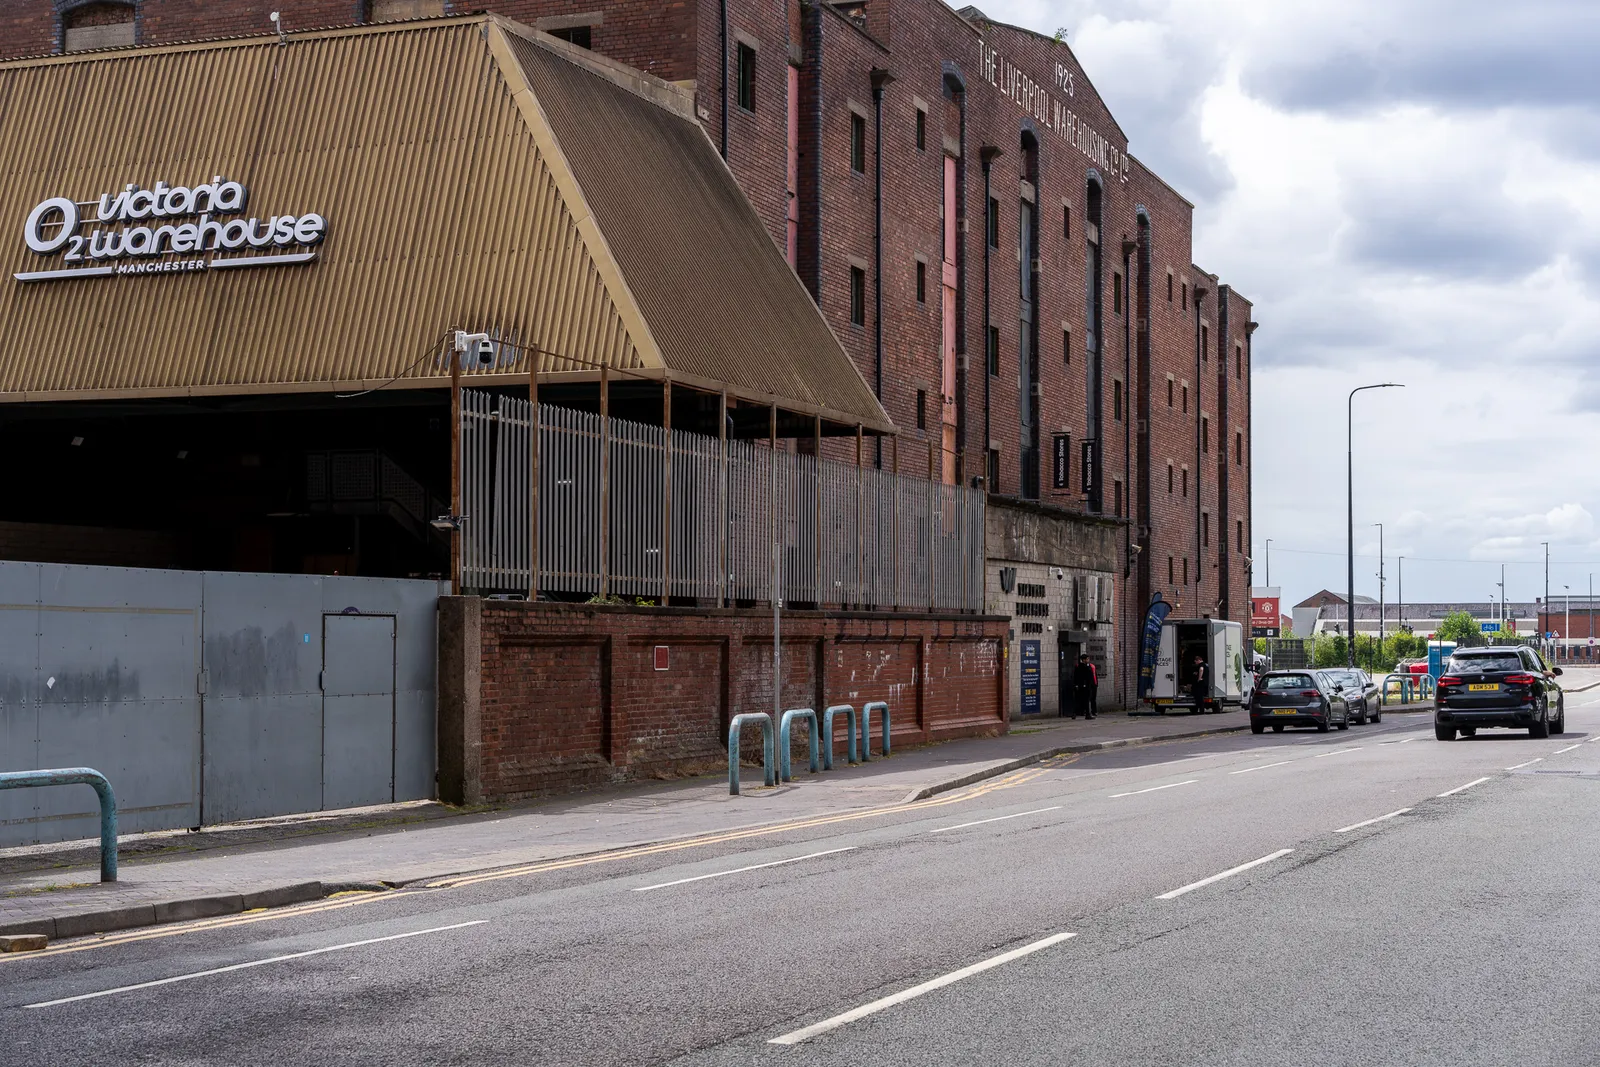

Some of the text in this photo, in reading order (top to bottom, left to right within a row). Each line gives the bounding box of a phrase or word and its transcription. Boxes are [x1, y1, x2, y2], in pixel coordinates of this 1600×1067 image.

[1055, 61, 1074, 97] 1925
[978, 39, 997, 87] THE
[1000, 57, 1051, 128] LIVERPOOL
[1054, 99, 1109, 171] WAREHOUSING
[90, 213, 325, 258] warehouse
[117, 260, 206, 274] MANCHESTER
